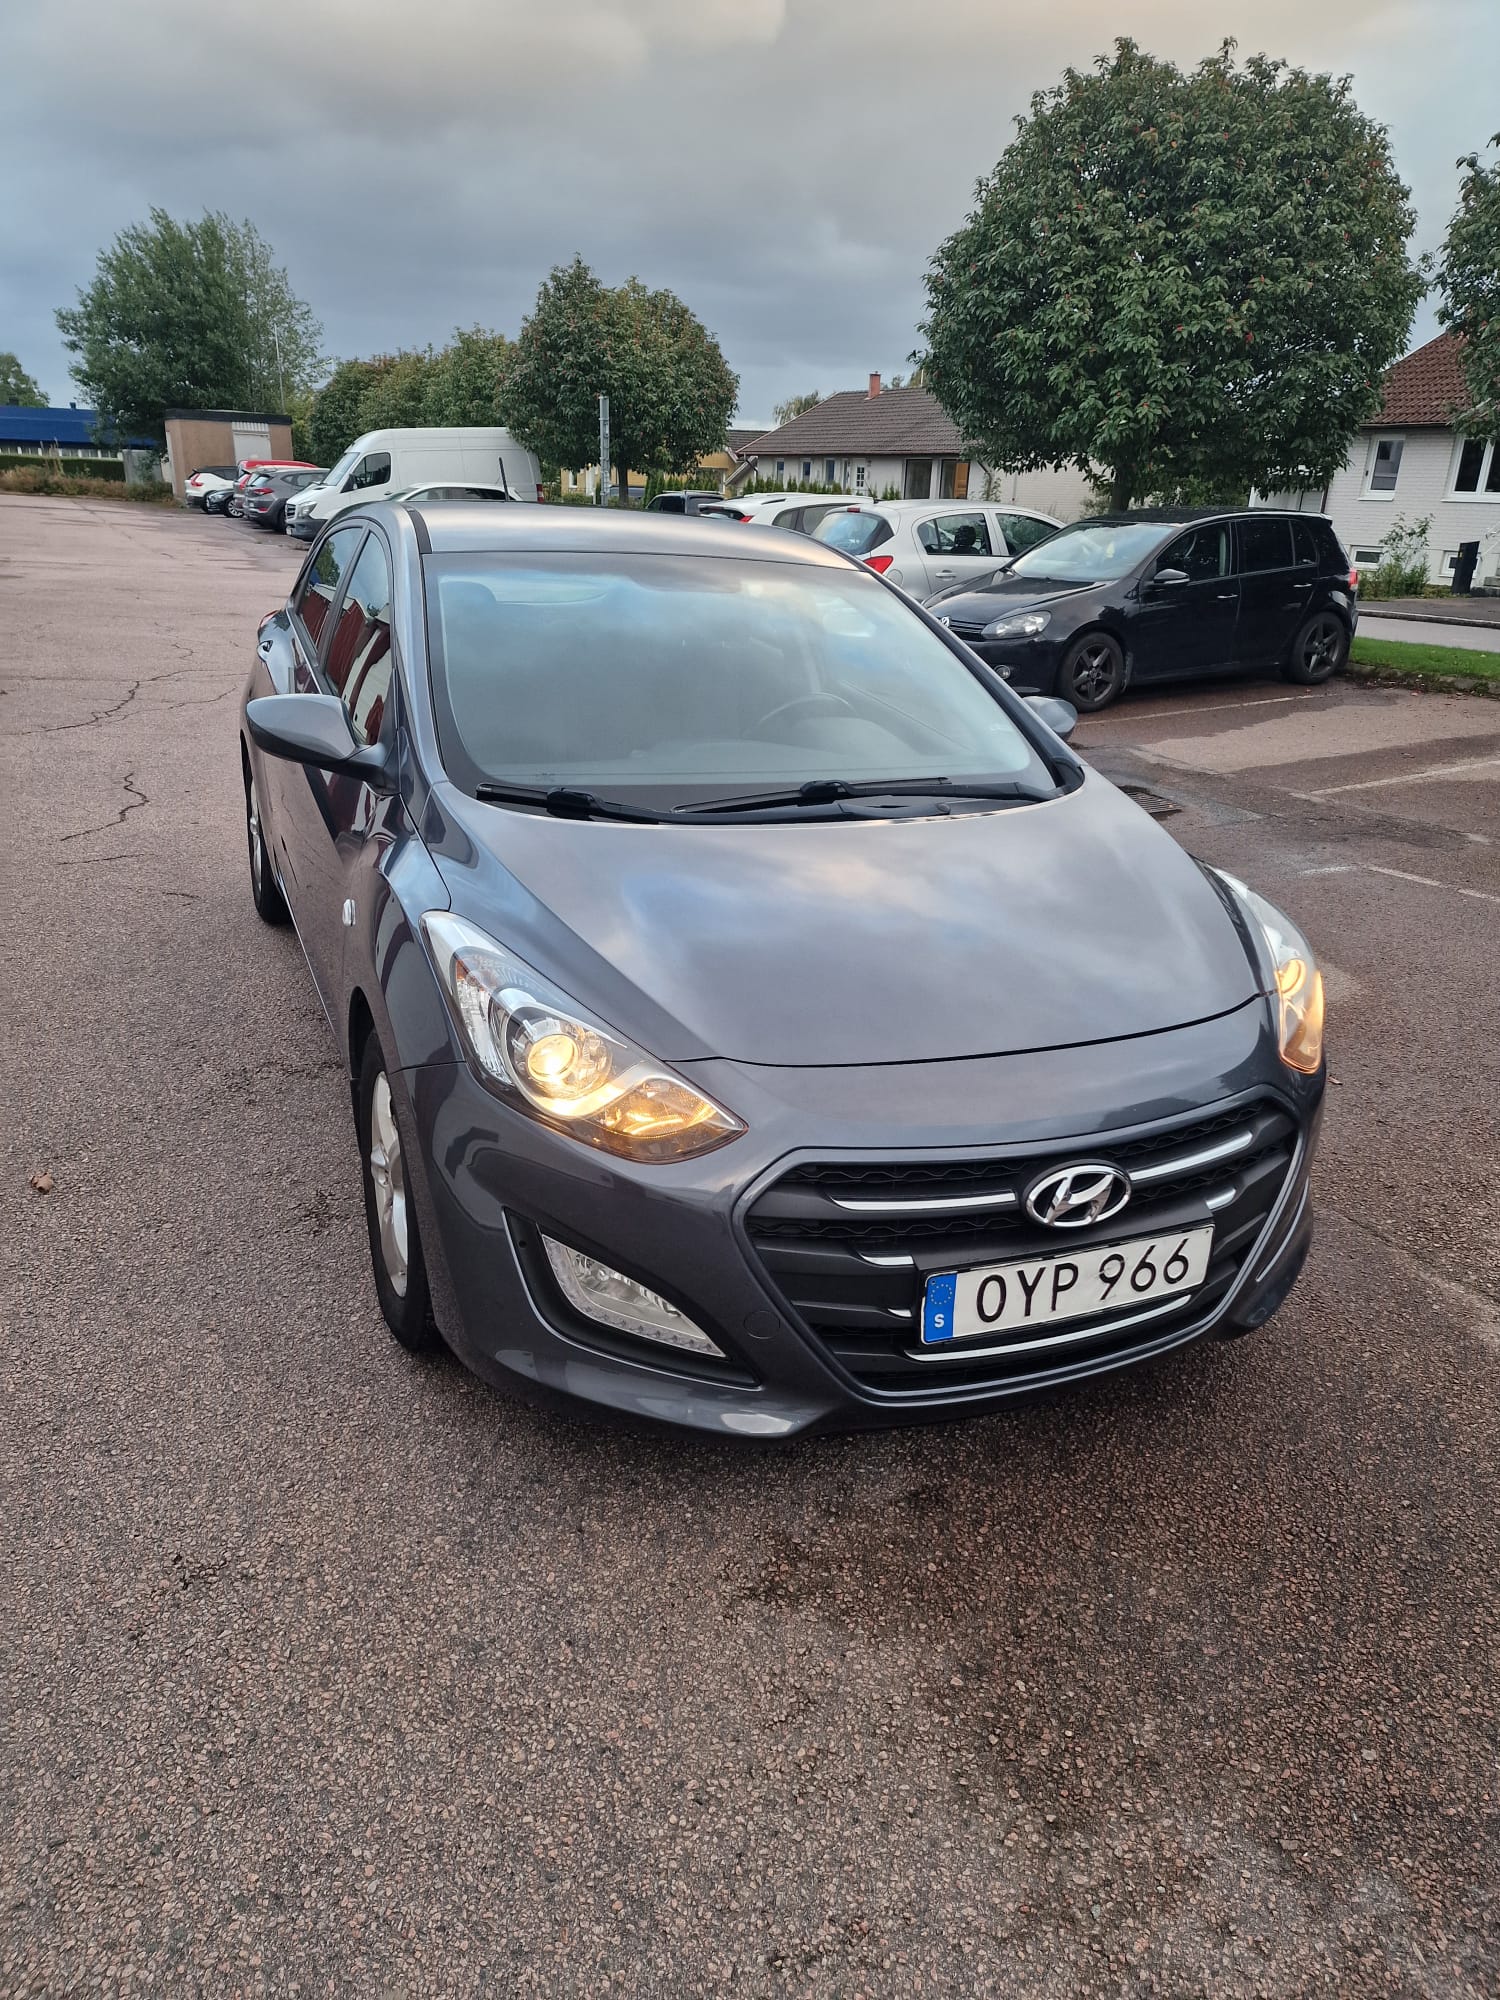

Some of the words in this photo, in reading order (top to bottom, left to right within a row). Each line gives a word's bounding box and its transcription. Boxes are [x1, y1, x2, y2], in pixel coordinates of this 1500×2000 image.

[977, 1263, 1079, 1322] OYP
[1099, 1239, 1190, 1300] 966
[934, 1313, 945, 1328] S
